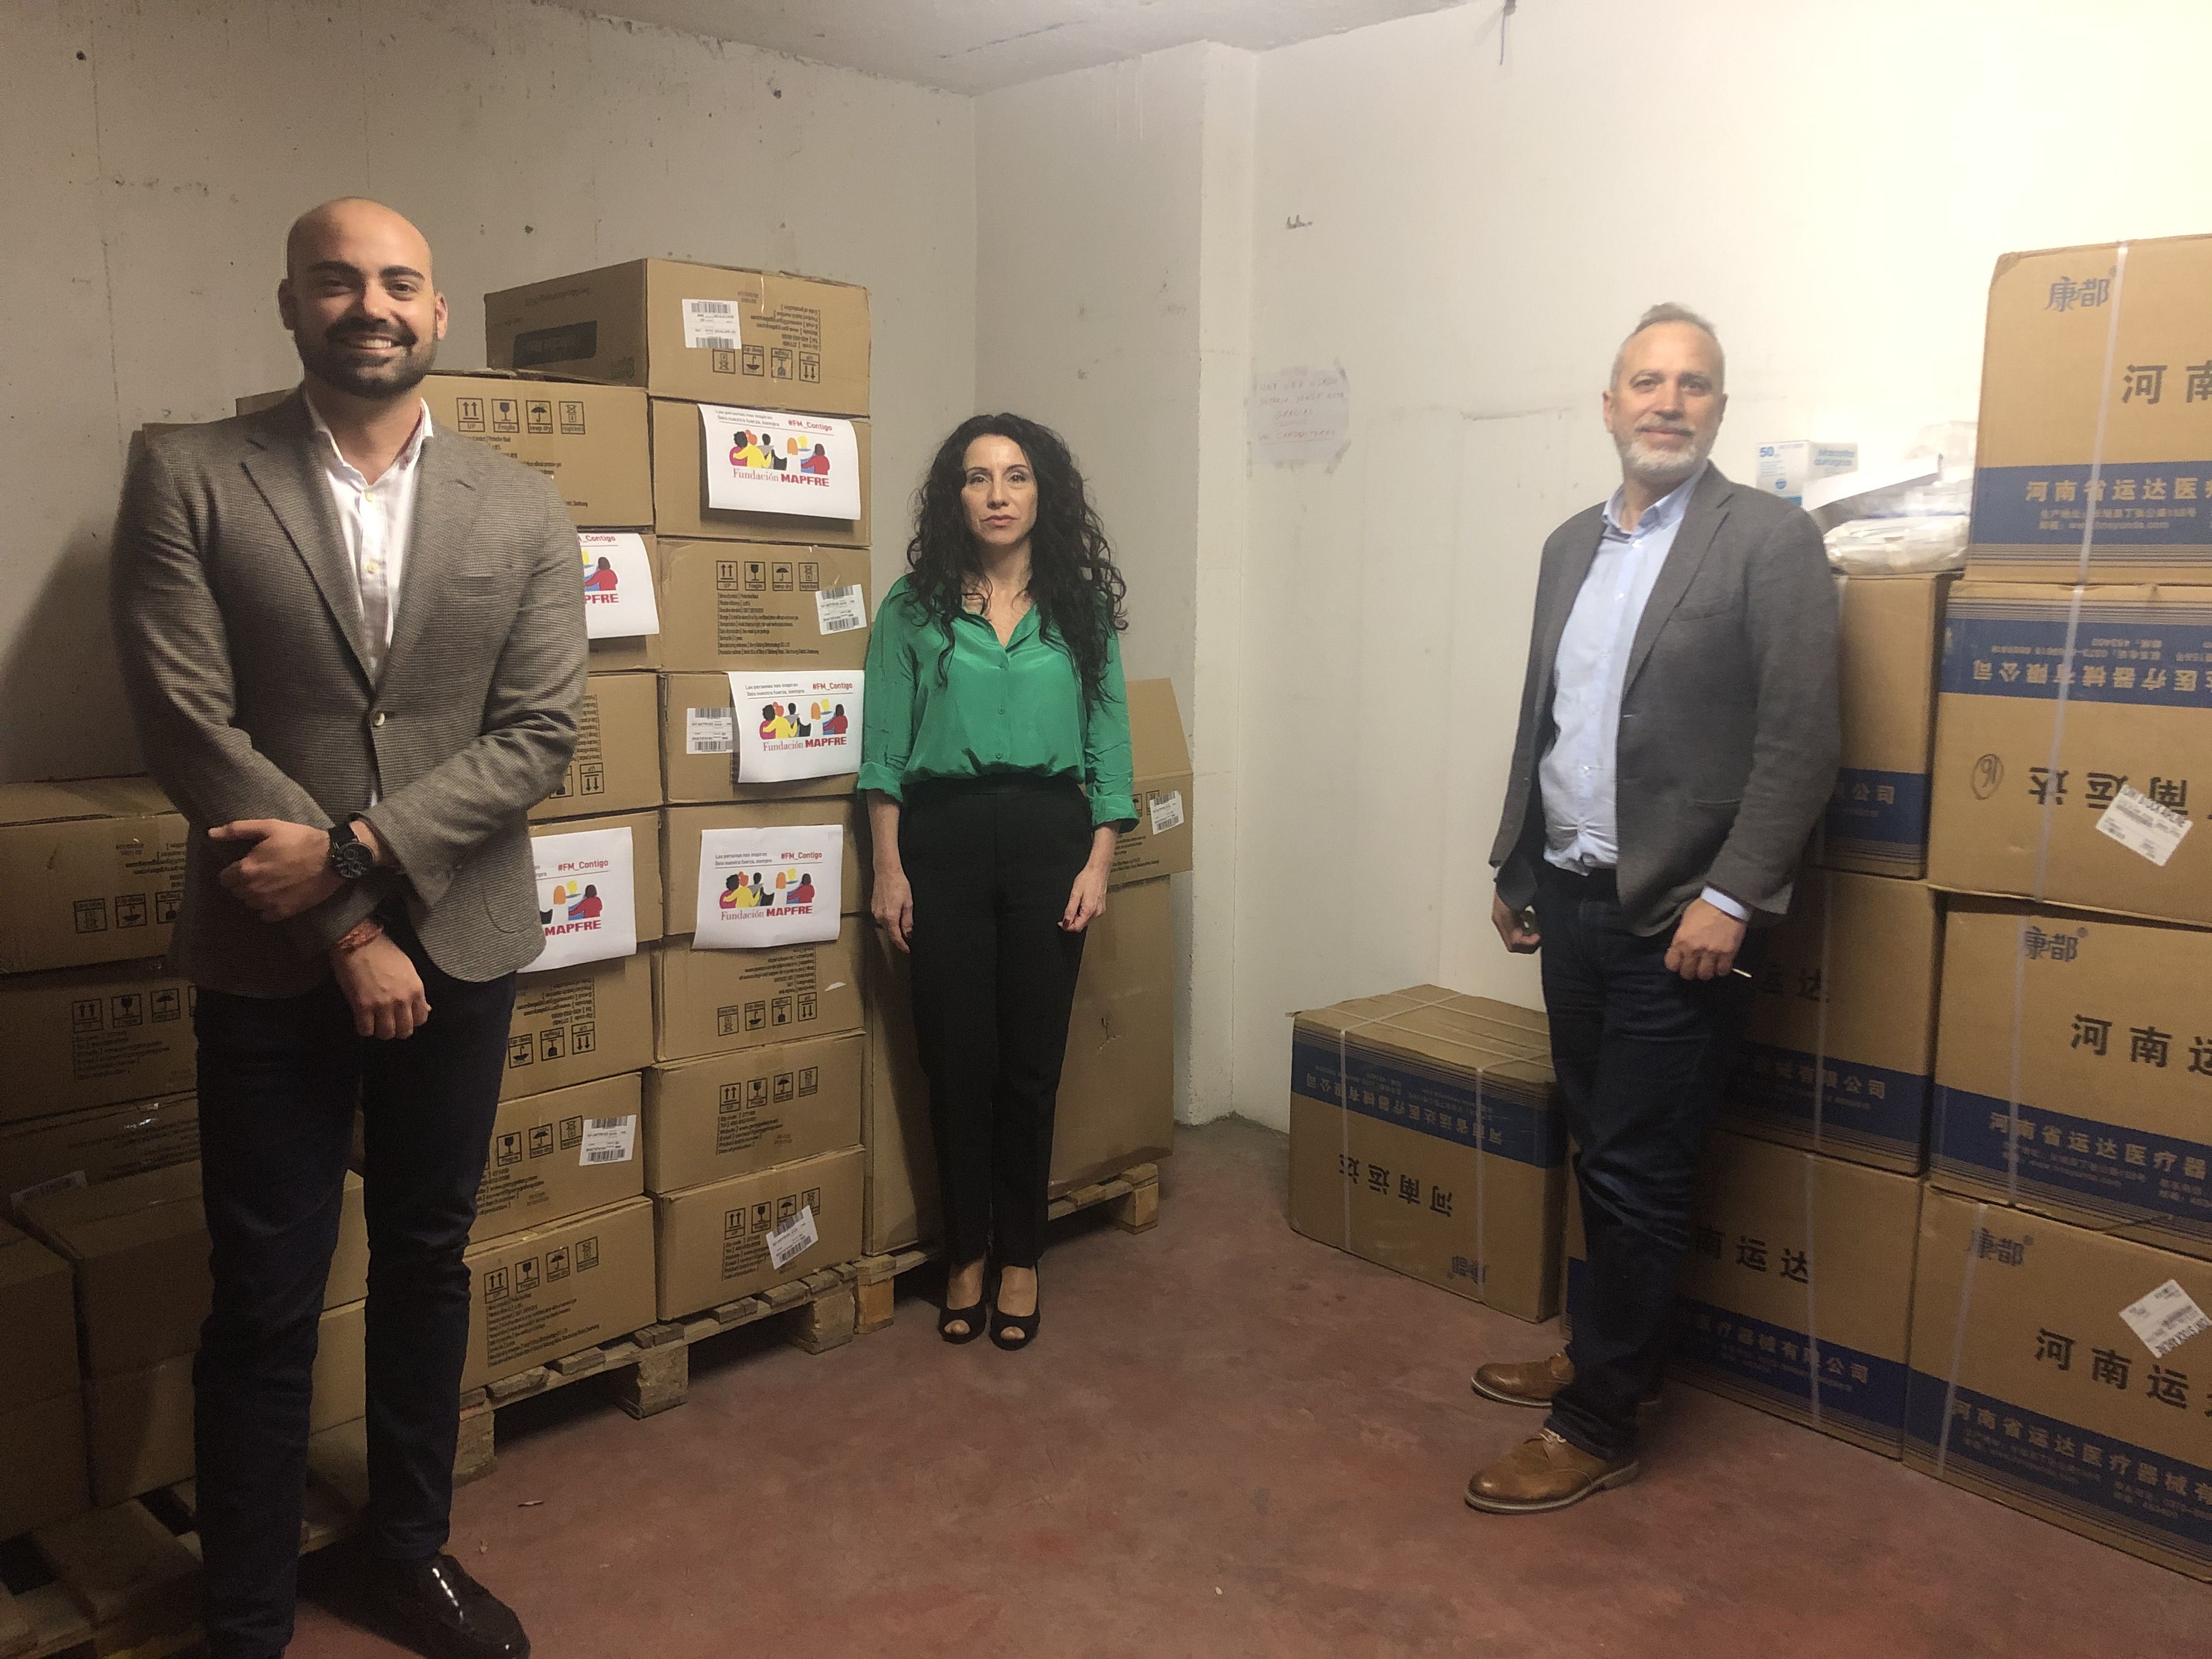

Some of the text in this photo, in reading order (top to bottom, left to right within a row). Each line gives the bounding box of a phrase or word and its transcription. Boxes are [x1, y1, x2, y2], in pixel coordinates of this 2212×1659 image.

[788, 420, 833, 431] #FM_Contigo
[733, 469, 830, 487] Fundación MAPFRE
[584, 594, 619, 604] PFRE
[812, 682, 853, 691] #FM_Contigo
[763, 737, 847, 752] Fundación MAPFRE
[2028, 766, 2212, 819] 南运达
[781, 851, 822, 860] #FM_Contigo
[558, 860, 608, 871] #FM_Contigo
[720, 906, 812, 921] Fundación MAPFRE
[545, 919, 601, 936] MAPFRE
[1339, 1153, 1453, 1217] 河南运达
[1688, 1224, 1812, 1284] 南运达
[2035, 1327, 2212, 1418] 河南运
